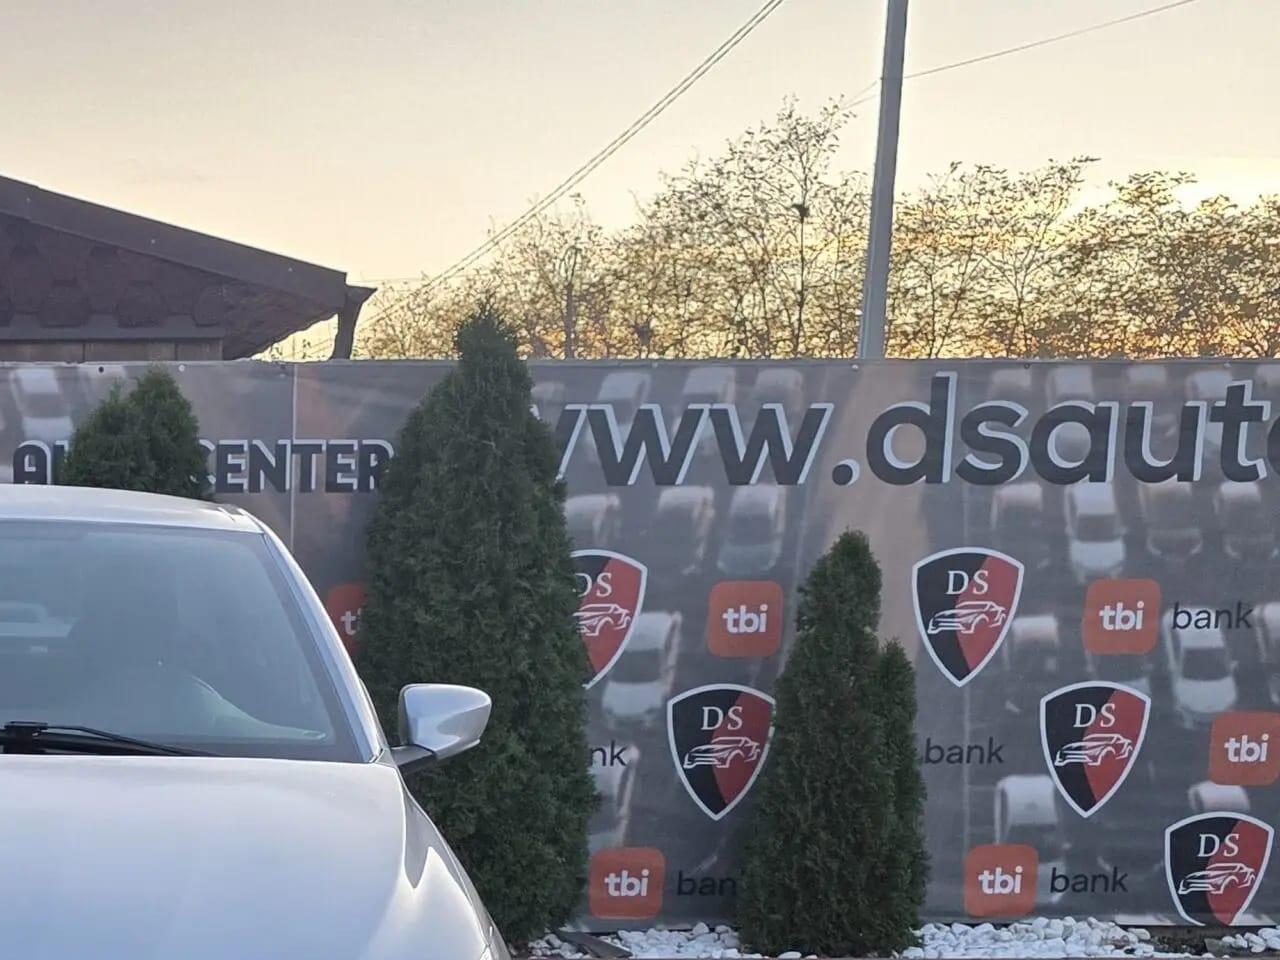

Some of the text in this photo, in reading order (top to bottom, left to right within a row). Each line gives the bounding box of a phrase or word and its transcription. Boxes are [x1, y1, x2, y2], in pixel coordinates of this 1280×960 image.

[529, 371, 1280, 485] ww.dsaut
[945, 569, 989, 595] DS
[723, 603, 768, 633] tbi
[1098, 601, 1253, 631] tbi bank
[701, 706, 743, 731] DS
[1073, 703, 1115, 728] DS
[925, 737, 1004, 765] bank
[1224, 734, 1269, 763] tbi
[1198, 833, 1239, 857] DS
[604, 869, 737, 897] tbi ban
[978, 866, 1128, 894] tbi bank
